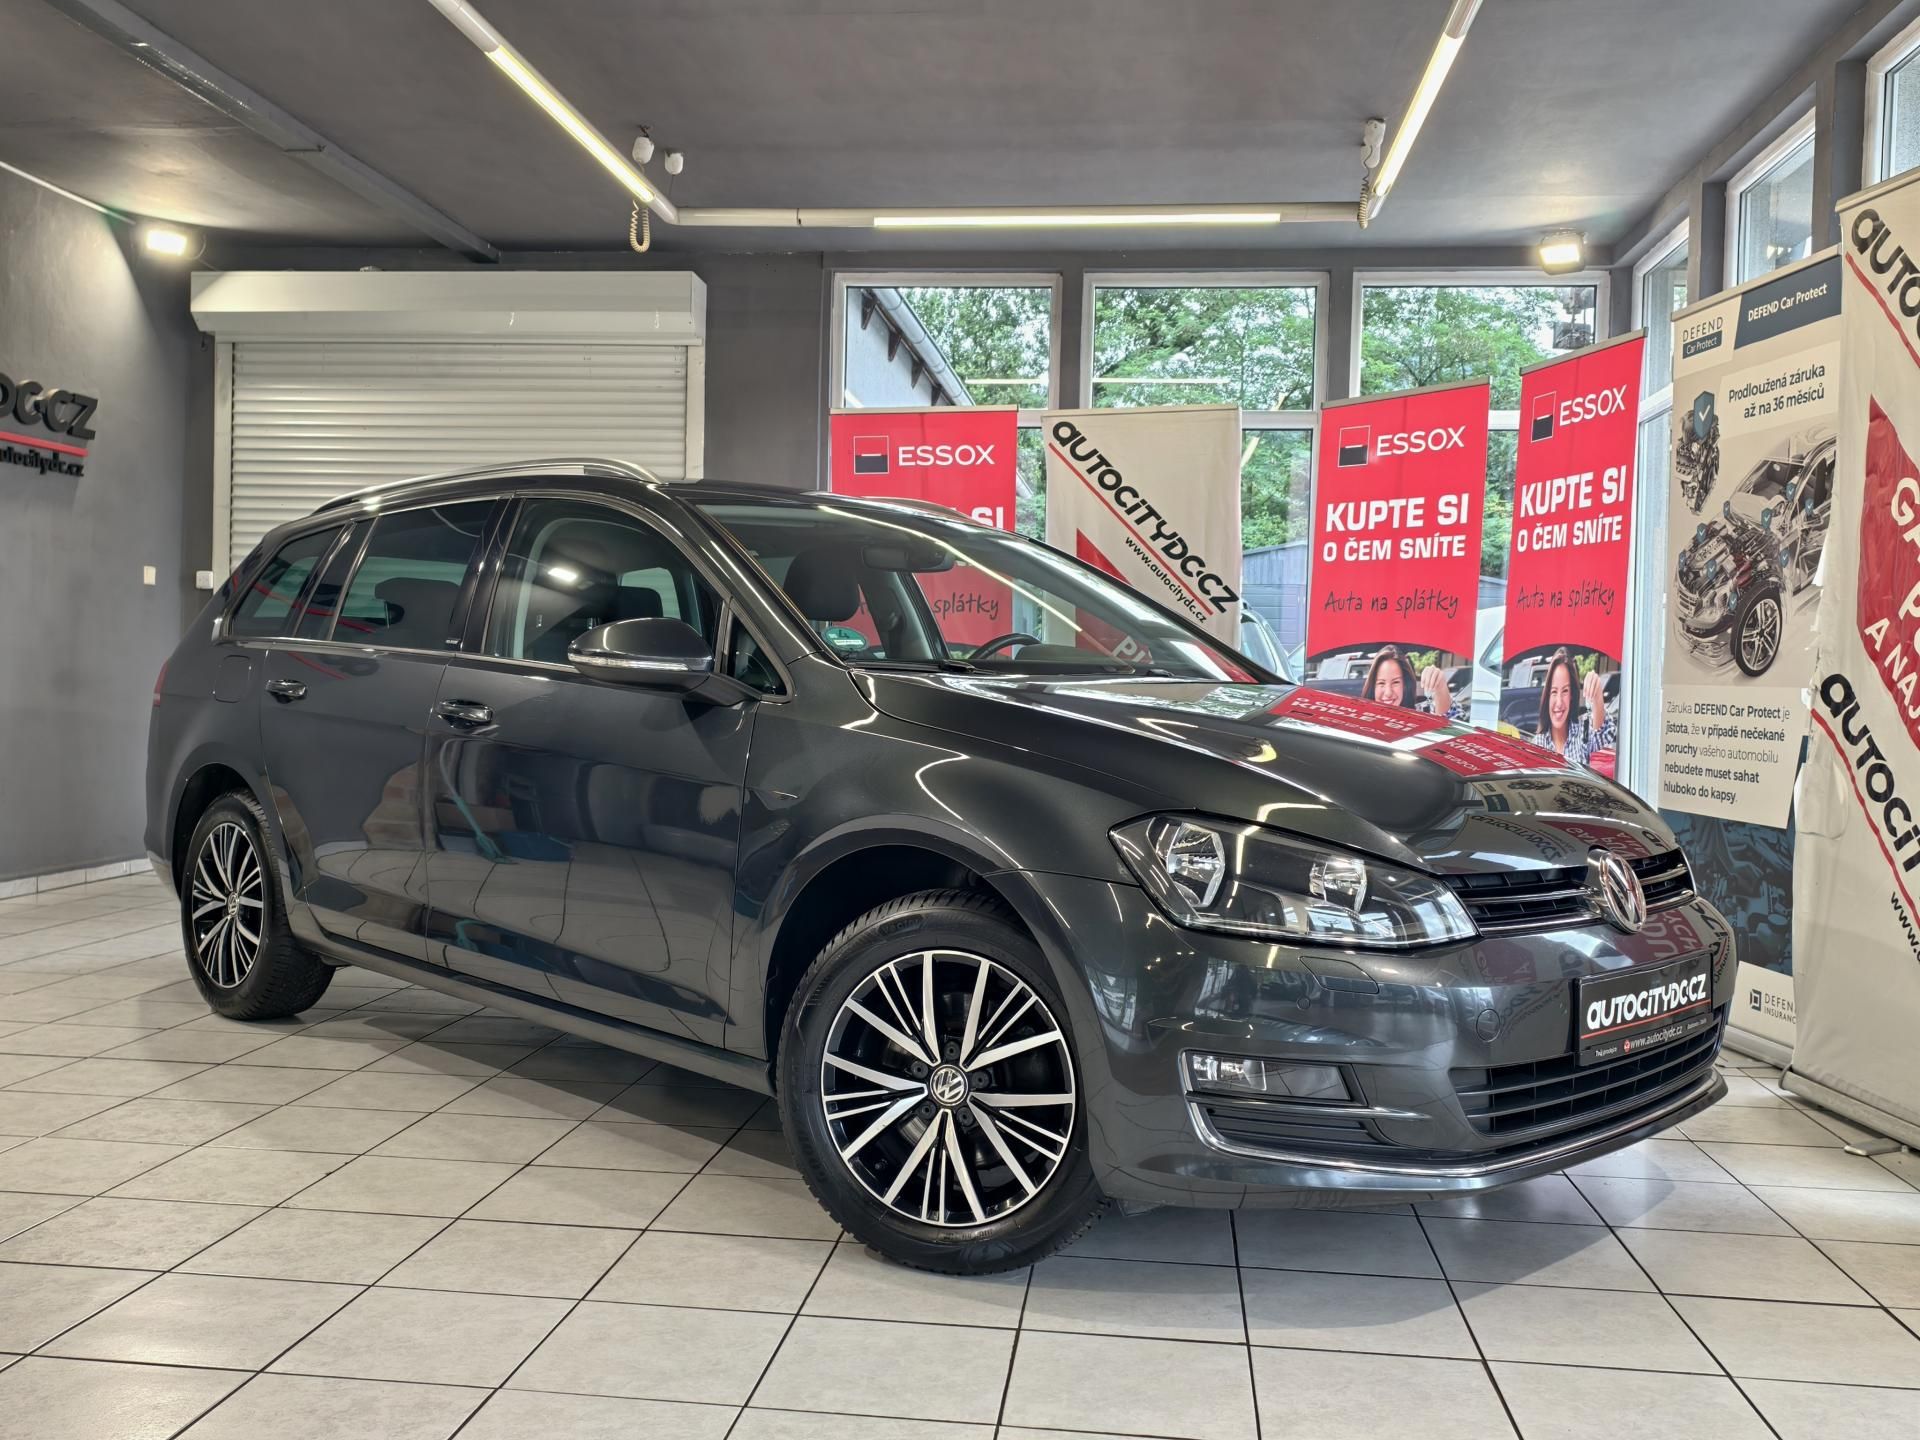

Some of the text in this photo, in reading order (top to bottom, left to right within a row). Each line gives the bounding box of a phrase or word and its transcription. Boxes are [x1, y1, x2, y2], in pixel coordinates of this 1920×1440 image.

[1748, 283, 1828, 322] DEFEND Car Protect
[1682, 316, 1724, 342] DEFEND
[1686, 336, 1718, 355] Car Protect
[1728, 364, 1826, 403] Prodloužená záruka
[1559, 384, 1628, 426] ESSOX
[1743, 382, 1825, 419] až na 36 měsíců
[898, 444, 996, 467] ESSOX
[1376, 425, 1467, 457] ESSOX
[1520, 464, 1627, 519] KUPTE SI
[1325, 493, 1470, 533] KUPTE SI
[1322, 532, 1467, 563] O ČEM SNÍTE
[1517, 512, 1623, 553] O ČEM SNÍTE
[1125, 536, 1207, 624] www.autocitydc.cz
[933, 592, 1001, 621] splátky
[1324, 587, 1459, 620] Auta na splátky
[1516, 580, 1616, 616] Auta na splátky
[1884, 643, 1920, 730] NAJ
[1666, 701, 1790, 722] Záruka DEFEND Car Protect je
[1665, 720, 1785, 742] jistota, že v případě nečekané
[1665, 742, 1779, 763] poruchy vašeho automobilu
[1664, 761, 1760, 783] nebudete muset sahat
[1663, 780, 1697, 796] hluboko
[1698, 785, 1709, 798] do
[1764, 993, 1796, 1013] DEFEN
[1630, 1025, 1684, 1049] www.autocitydc.cz
